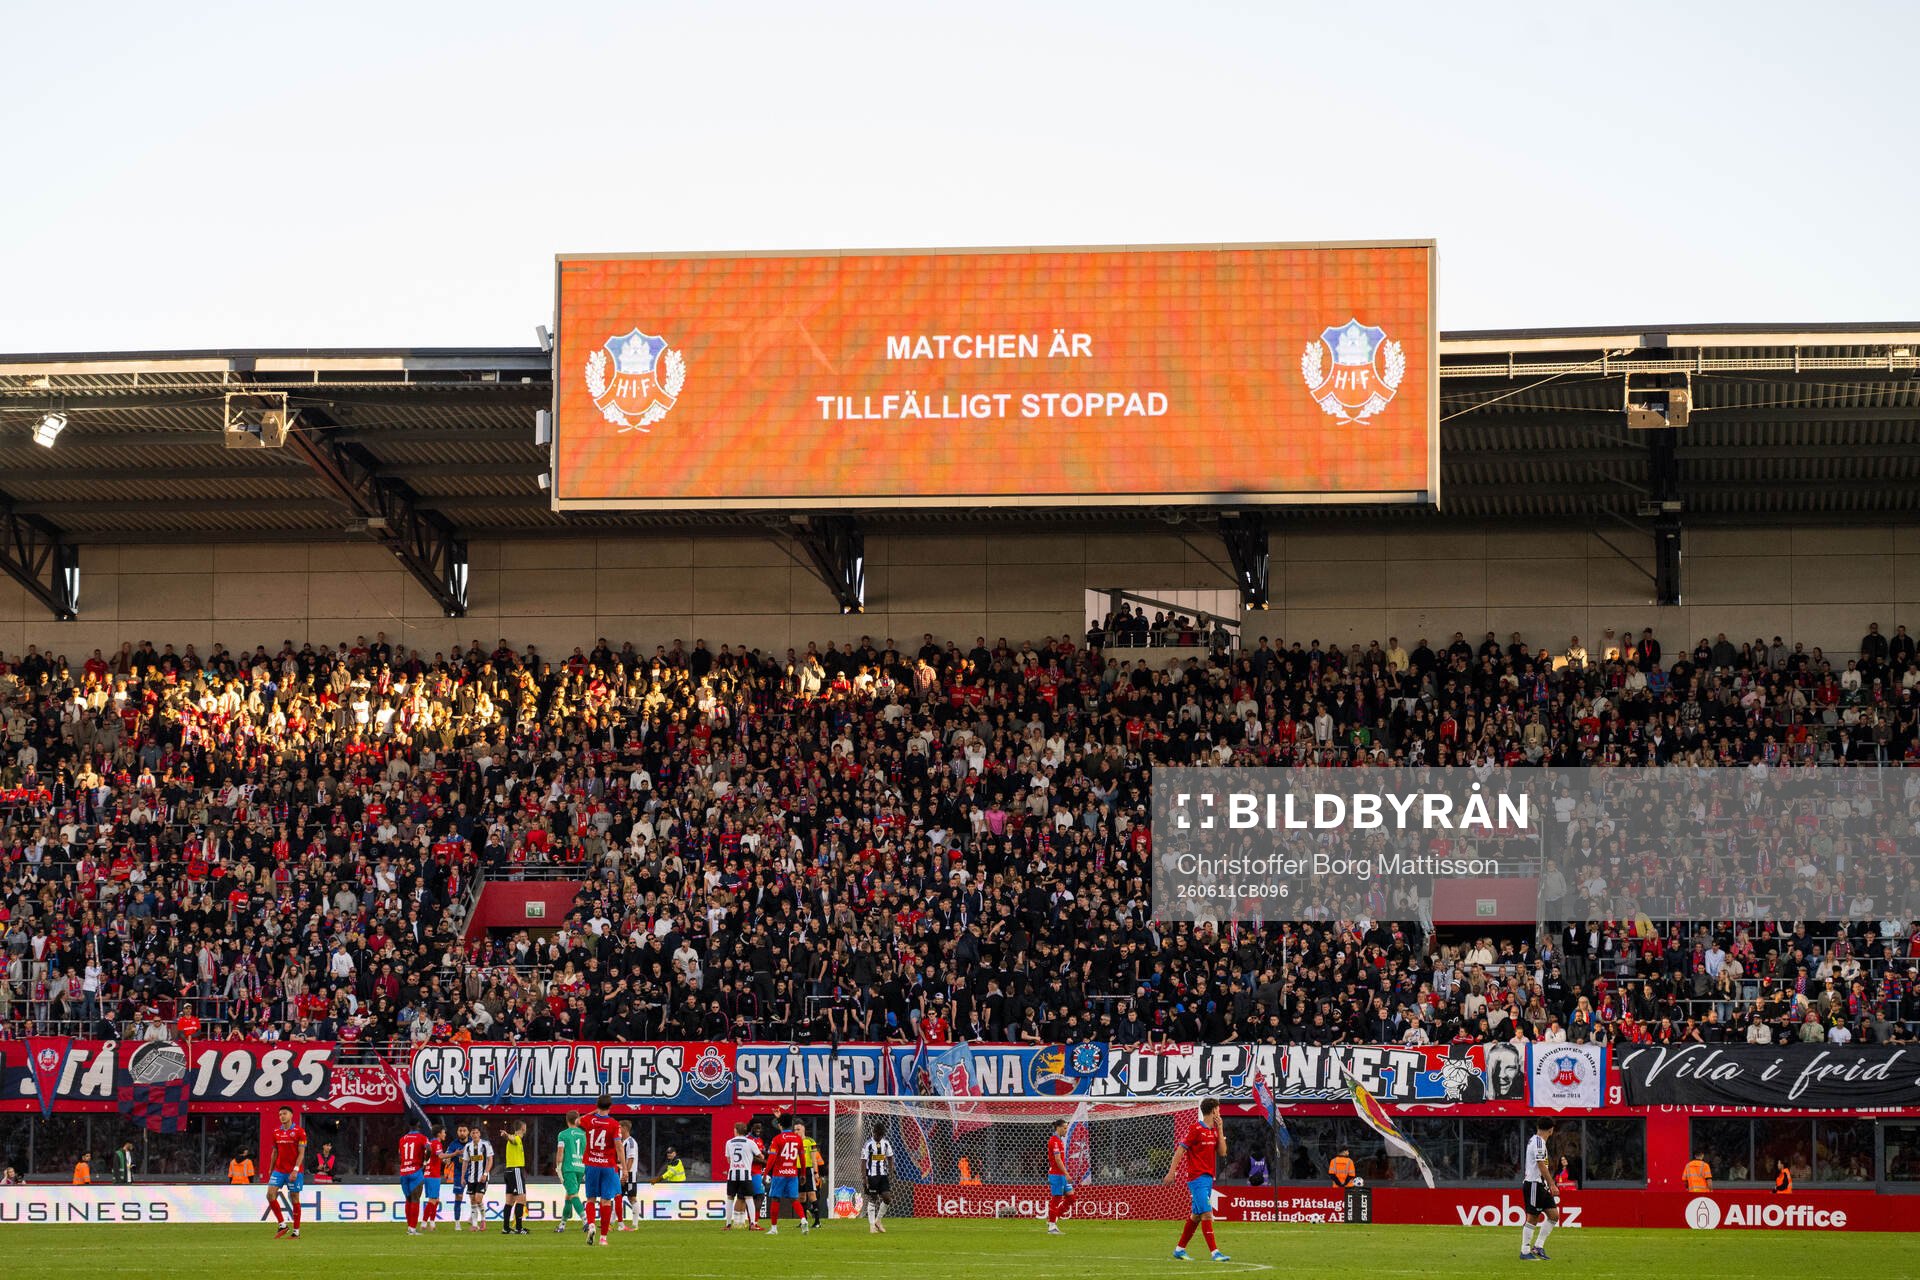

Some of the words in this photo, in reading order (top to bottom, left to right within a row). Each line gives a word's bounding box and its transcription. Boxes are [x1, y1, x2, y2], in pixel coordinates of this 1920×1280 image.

[887, 334, 1037, 360] MATCHEN
[1048, 328, 1092, 358] ÄR
[816, 390, 1011, 420] TILLFÄLLIGT
[1022, 391, 1169, 418] STOPPAD
[192, 1050, 332, 1097] 1985
[411, 1045, 684, 1099] CREWMATES
[1622, 1045, 1745, 1088] Vila
[1761, 1058, 1784, 1082] i
[1788, 1050, 1907, 1100] frid
[329, 1077, 398, 1101] rlsberg
[575, 1139, 581, 1157] 1
[589, 1129, 607, 1150] 14
[403, 1142, 415, 1160] 11
[733, 1148, 743, 1163] 5
[781, 1142, 799, 1160] 45
[1231, 1197, 1289, 1209] Jönssons
[1243, 1210, 1248, 1221] i
[1250, 1210, 1326, 1223] Helsingbog
[1724, 1203, 1848, 1228] AllOffice
